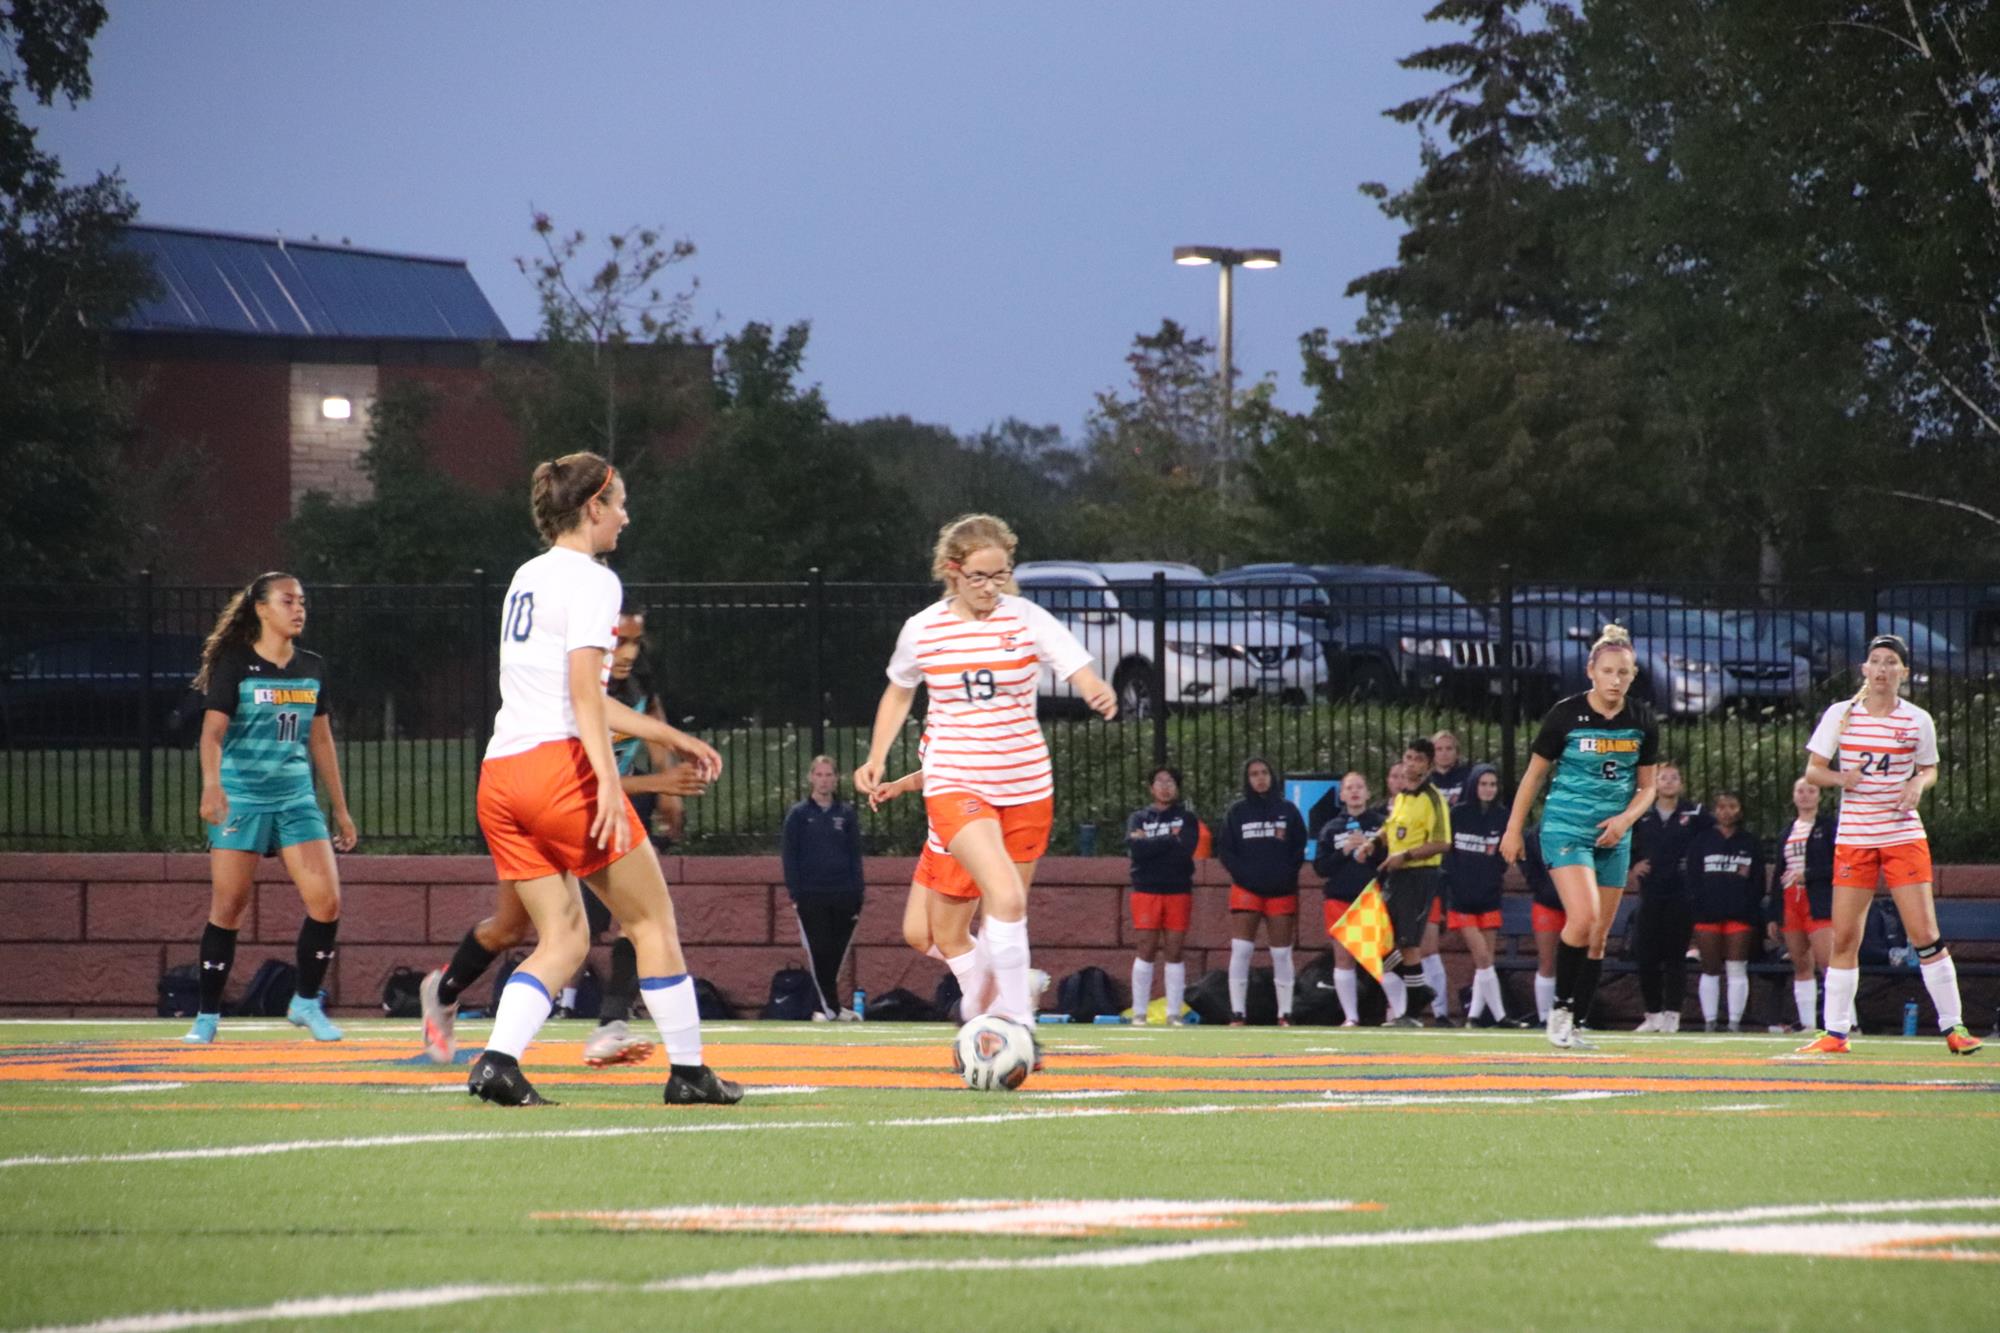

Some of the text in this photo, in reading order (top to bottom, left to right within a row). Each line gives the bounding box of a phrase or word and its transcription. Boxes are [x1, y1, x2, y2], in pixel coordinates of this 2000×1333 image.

[504, 591, 534, 642] 10
[962, 669, 995, 702] 19
[276, 712, 299, 743] 11
[1860, 752, 1891, 776] 24
